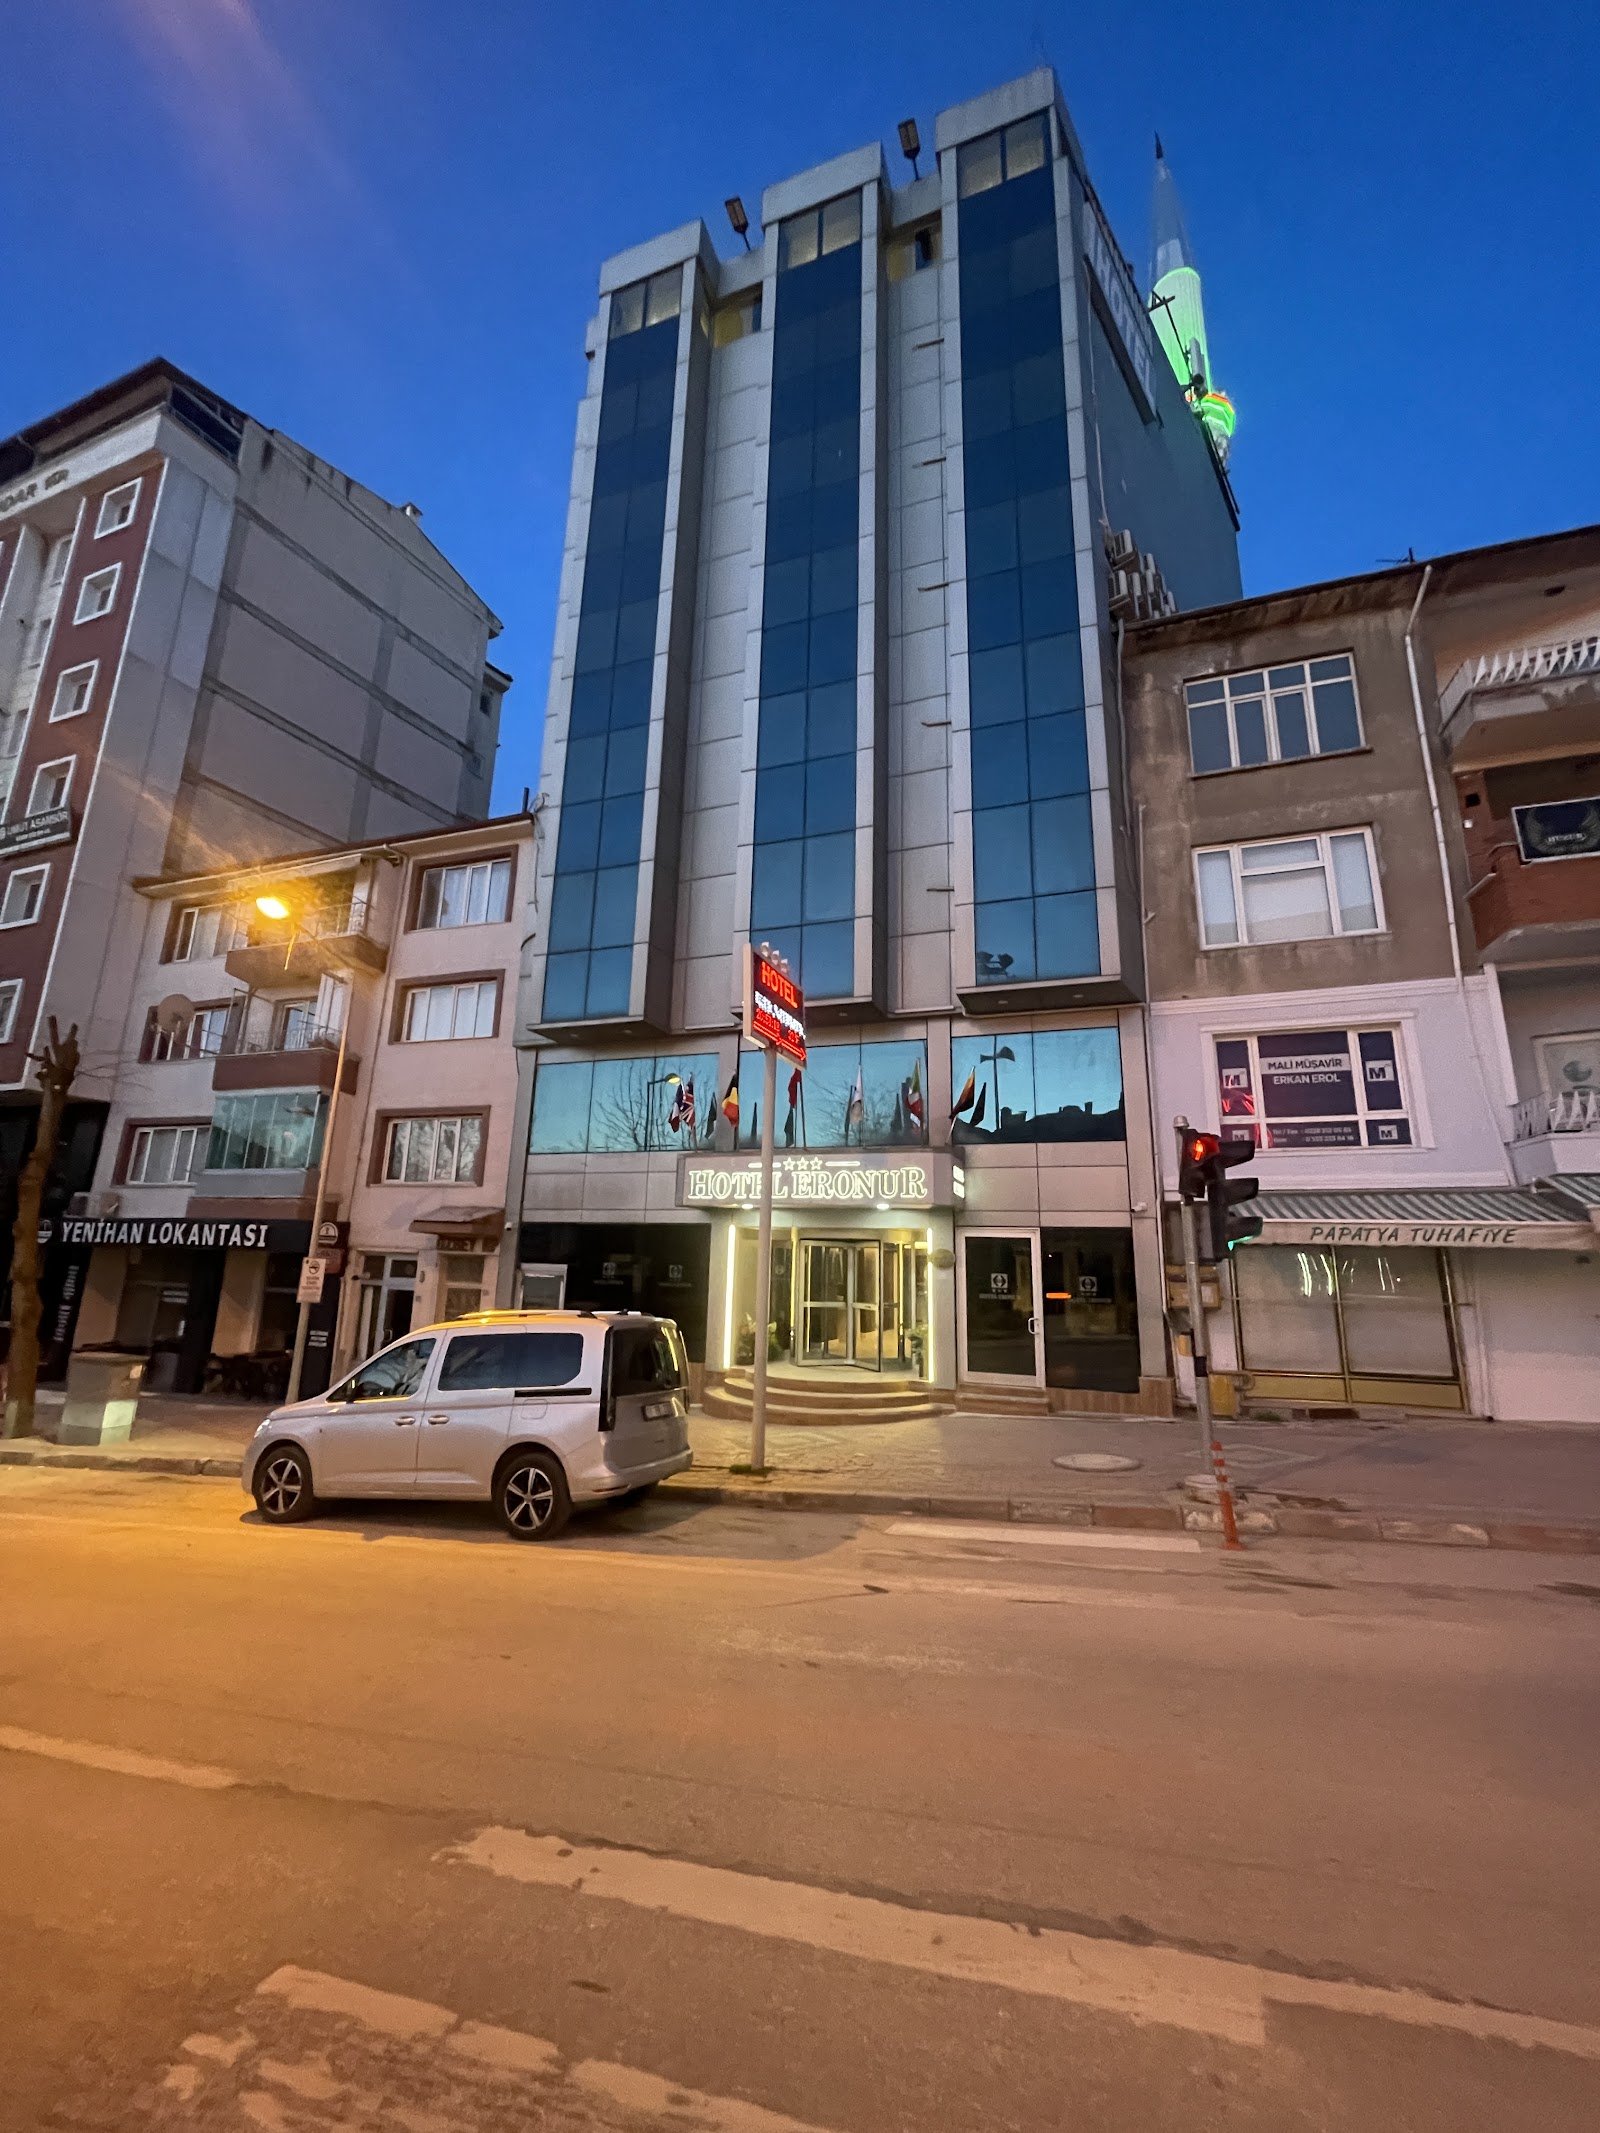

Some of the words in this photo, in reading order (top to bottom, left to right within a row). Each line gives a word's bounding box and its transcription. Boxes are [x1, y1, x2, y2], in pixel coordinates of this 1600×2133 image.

[761, 961, 798, 1008] HOTEL
[1268, 1060, 1293, 1070] MALİ
[1295, 1058, 1342, 1071] MÜŞAVİR
[1273, 1075, 1310, 1085] ERKAN
[1312, 1074, 1341, 1084] EROL
[791, 1166, 928, 1200] ERONUR
[62, 1219, 143, 1243] YENİHAN
[147, 1222, 268, 1247] LOKANTASI
[1310, 1226, 1399, 1241] PAPATYA
